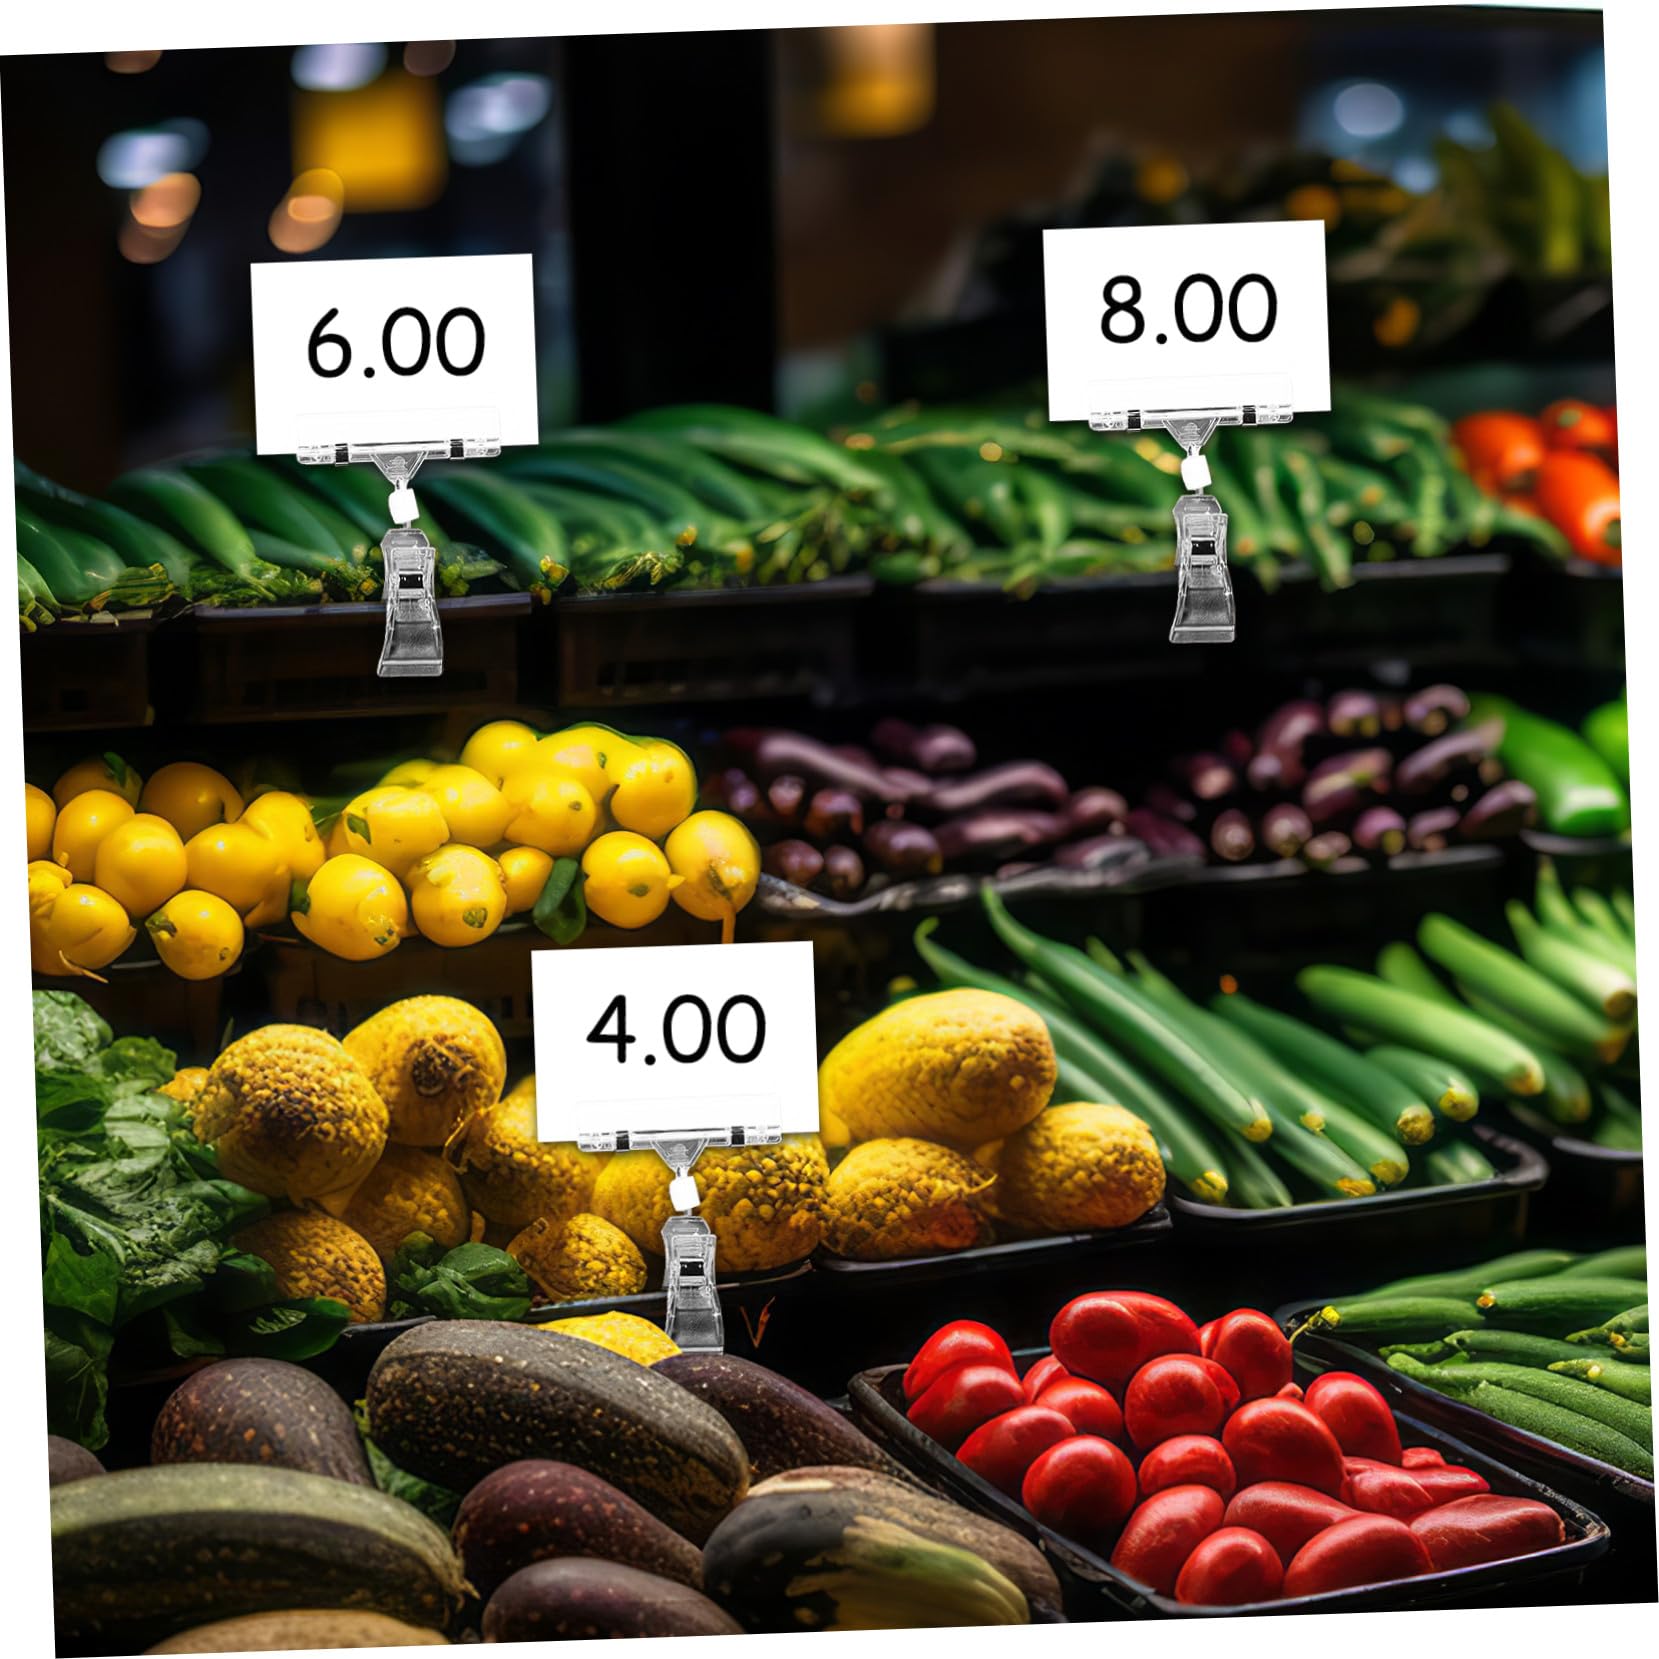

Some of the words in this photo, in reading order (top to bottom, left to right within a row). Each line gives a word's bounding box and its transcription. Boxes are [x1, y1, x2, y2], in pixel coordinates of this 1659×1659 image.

[307, 306, 486, 379] 6.00
[1100, 272, 1278, 345] 8.00
[586, 994, 766, 1066] 4.00
